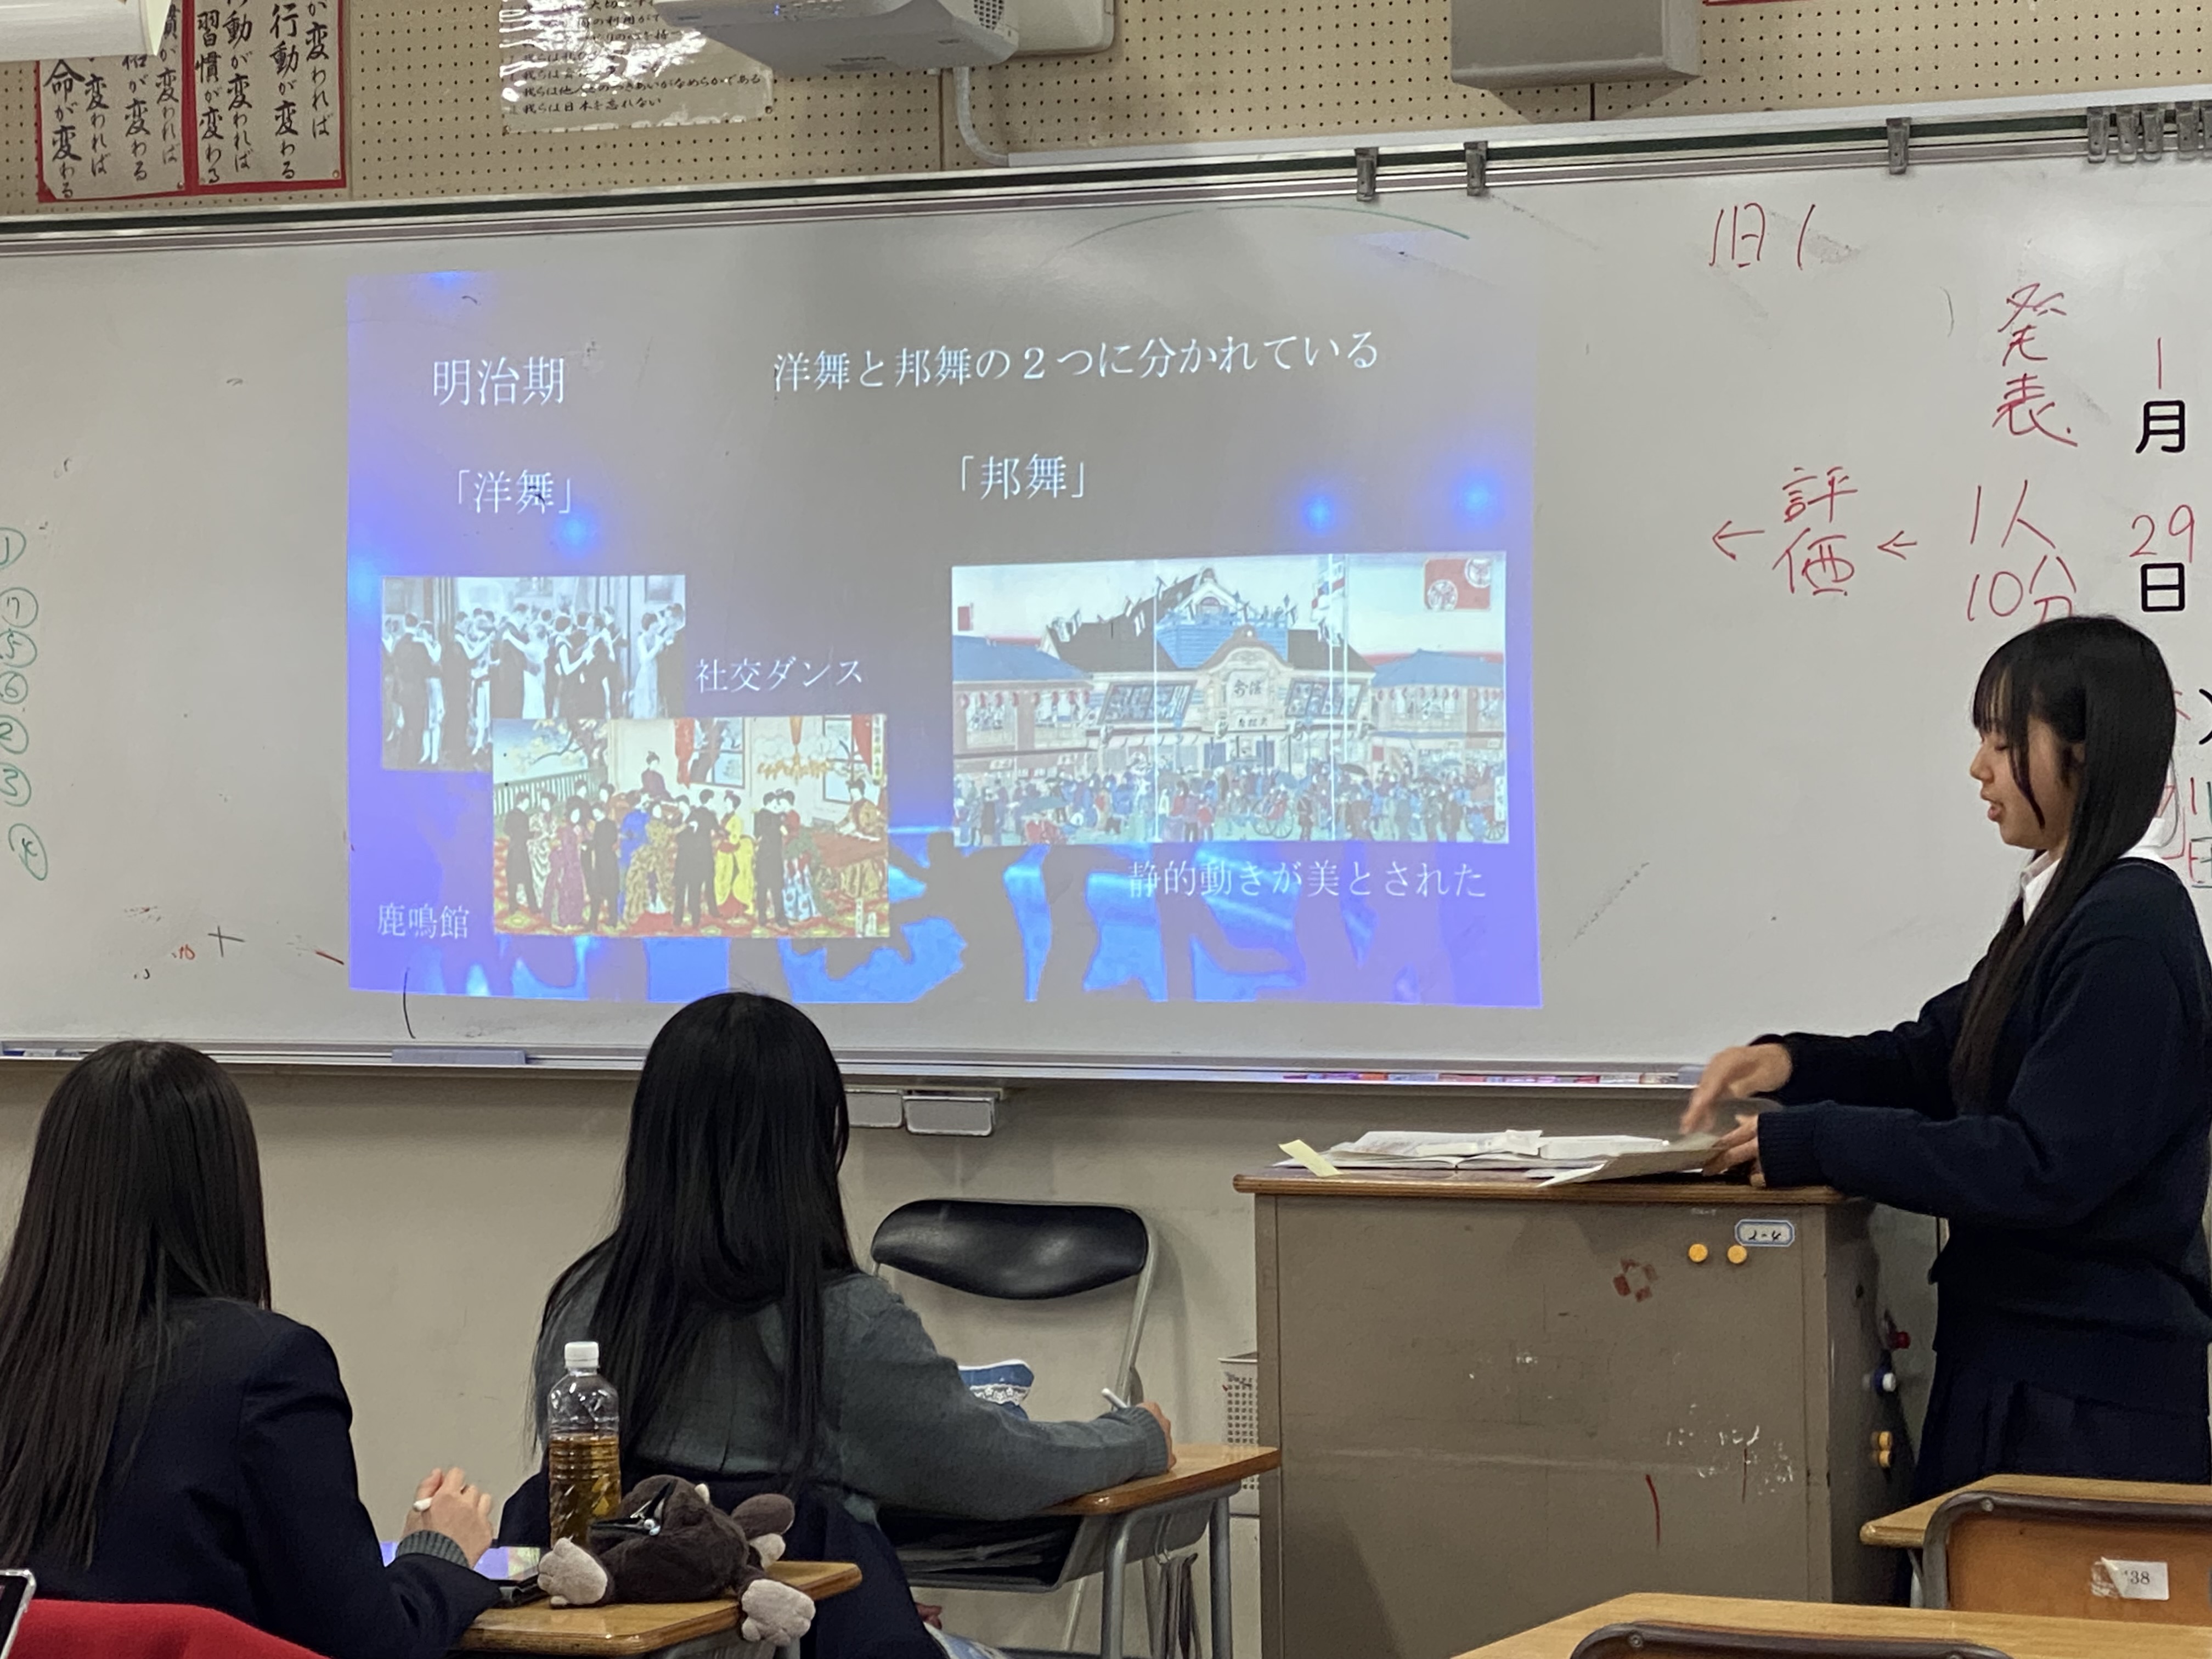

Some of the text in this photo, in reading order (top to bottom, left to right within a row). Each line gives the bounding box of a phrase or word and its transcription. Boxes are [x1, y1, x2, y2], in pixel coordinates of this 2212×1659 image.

[195, 9, 224, 184] 習慣が変わる
[222, 0, 252, 172] 動が変われば
[269, 3, 298, 179] 行動が変わる
[85, 57, 109, 177] 変われば
[433, 356, 566, 407] 明治期
[456, 469, 571, 515] 「洋舞」
[961, 453, 1084, 499] 「邦舞」
[1771, 466, 1858, 596] 評価
[695, 655, 862, 694] 社交ダンス
[1126, 860, 1487, 899] 静的動きが美とされた
[377, 902, 470, 940] 鹿鳴館
